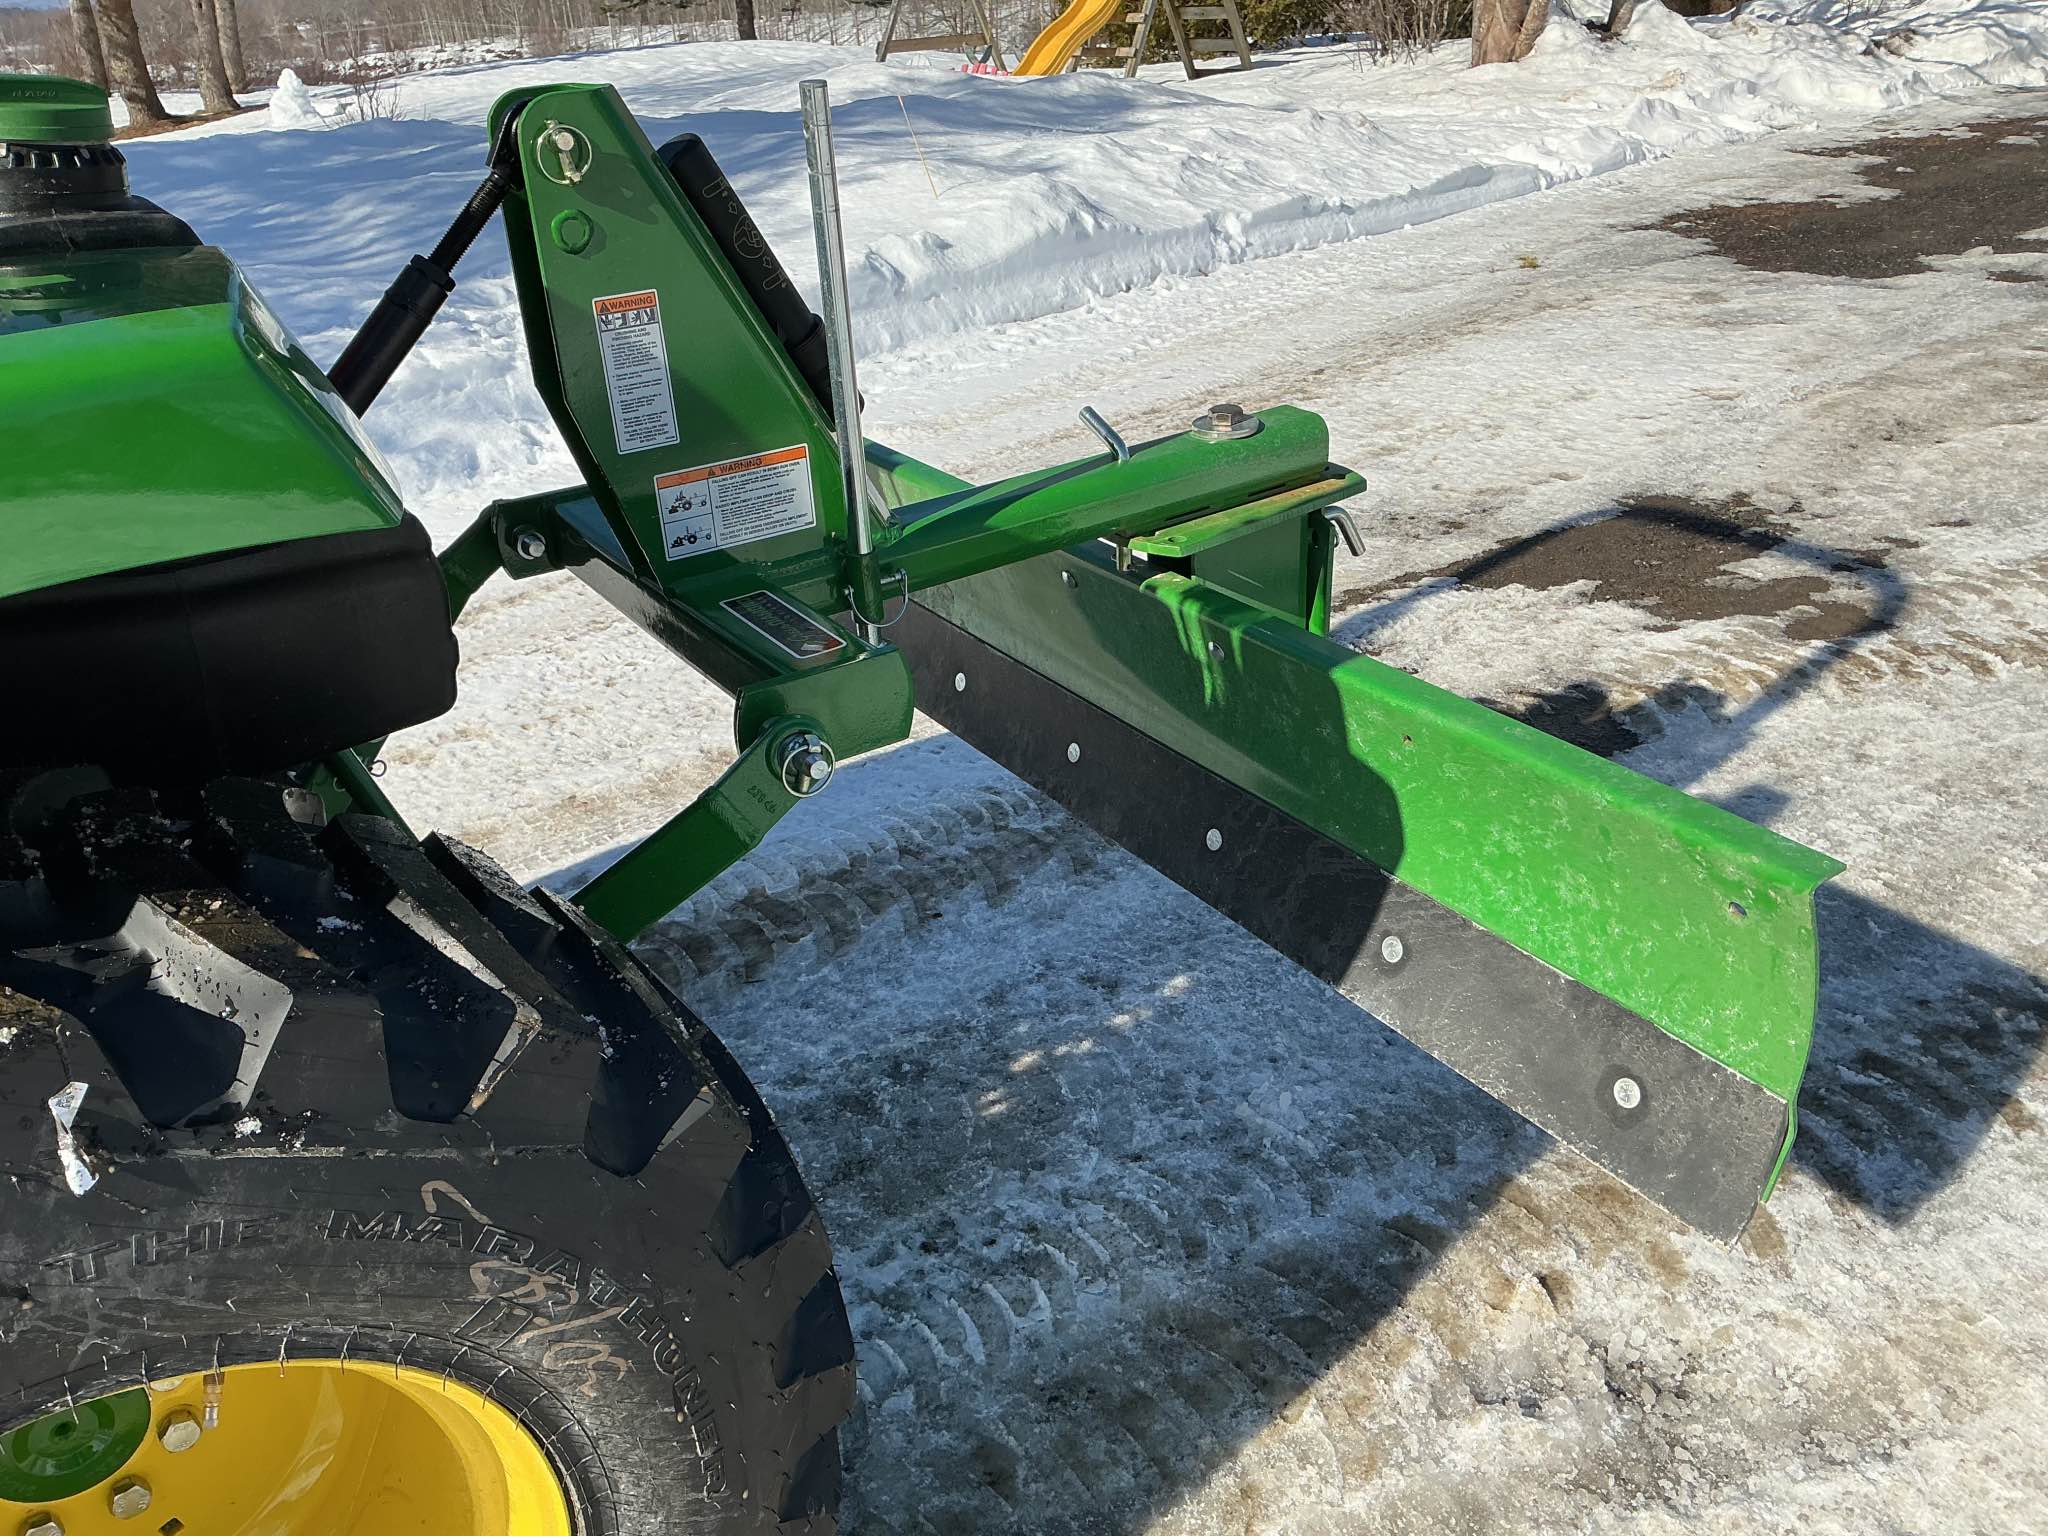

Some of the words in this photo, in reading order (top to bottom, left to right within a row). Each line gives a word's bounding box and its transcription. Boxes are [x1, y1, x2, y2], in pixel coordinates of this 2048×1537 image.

[609, 296, 653, 310] WARNING
[720, 458, 762, 473] WARNING
[39, 1215, 281, 1286] THE
[315, 1209, 728, 1502] MARATHONER
